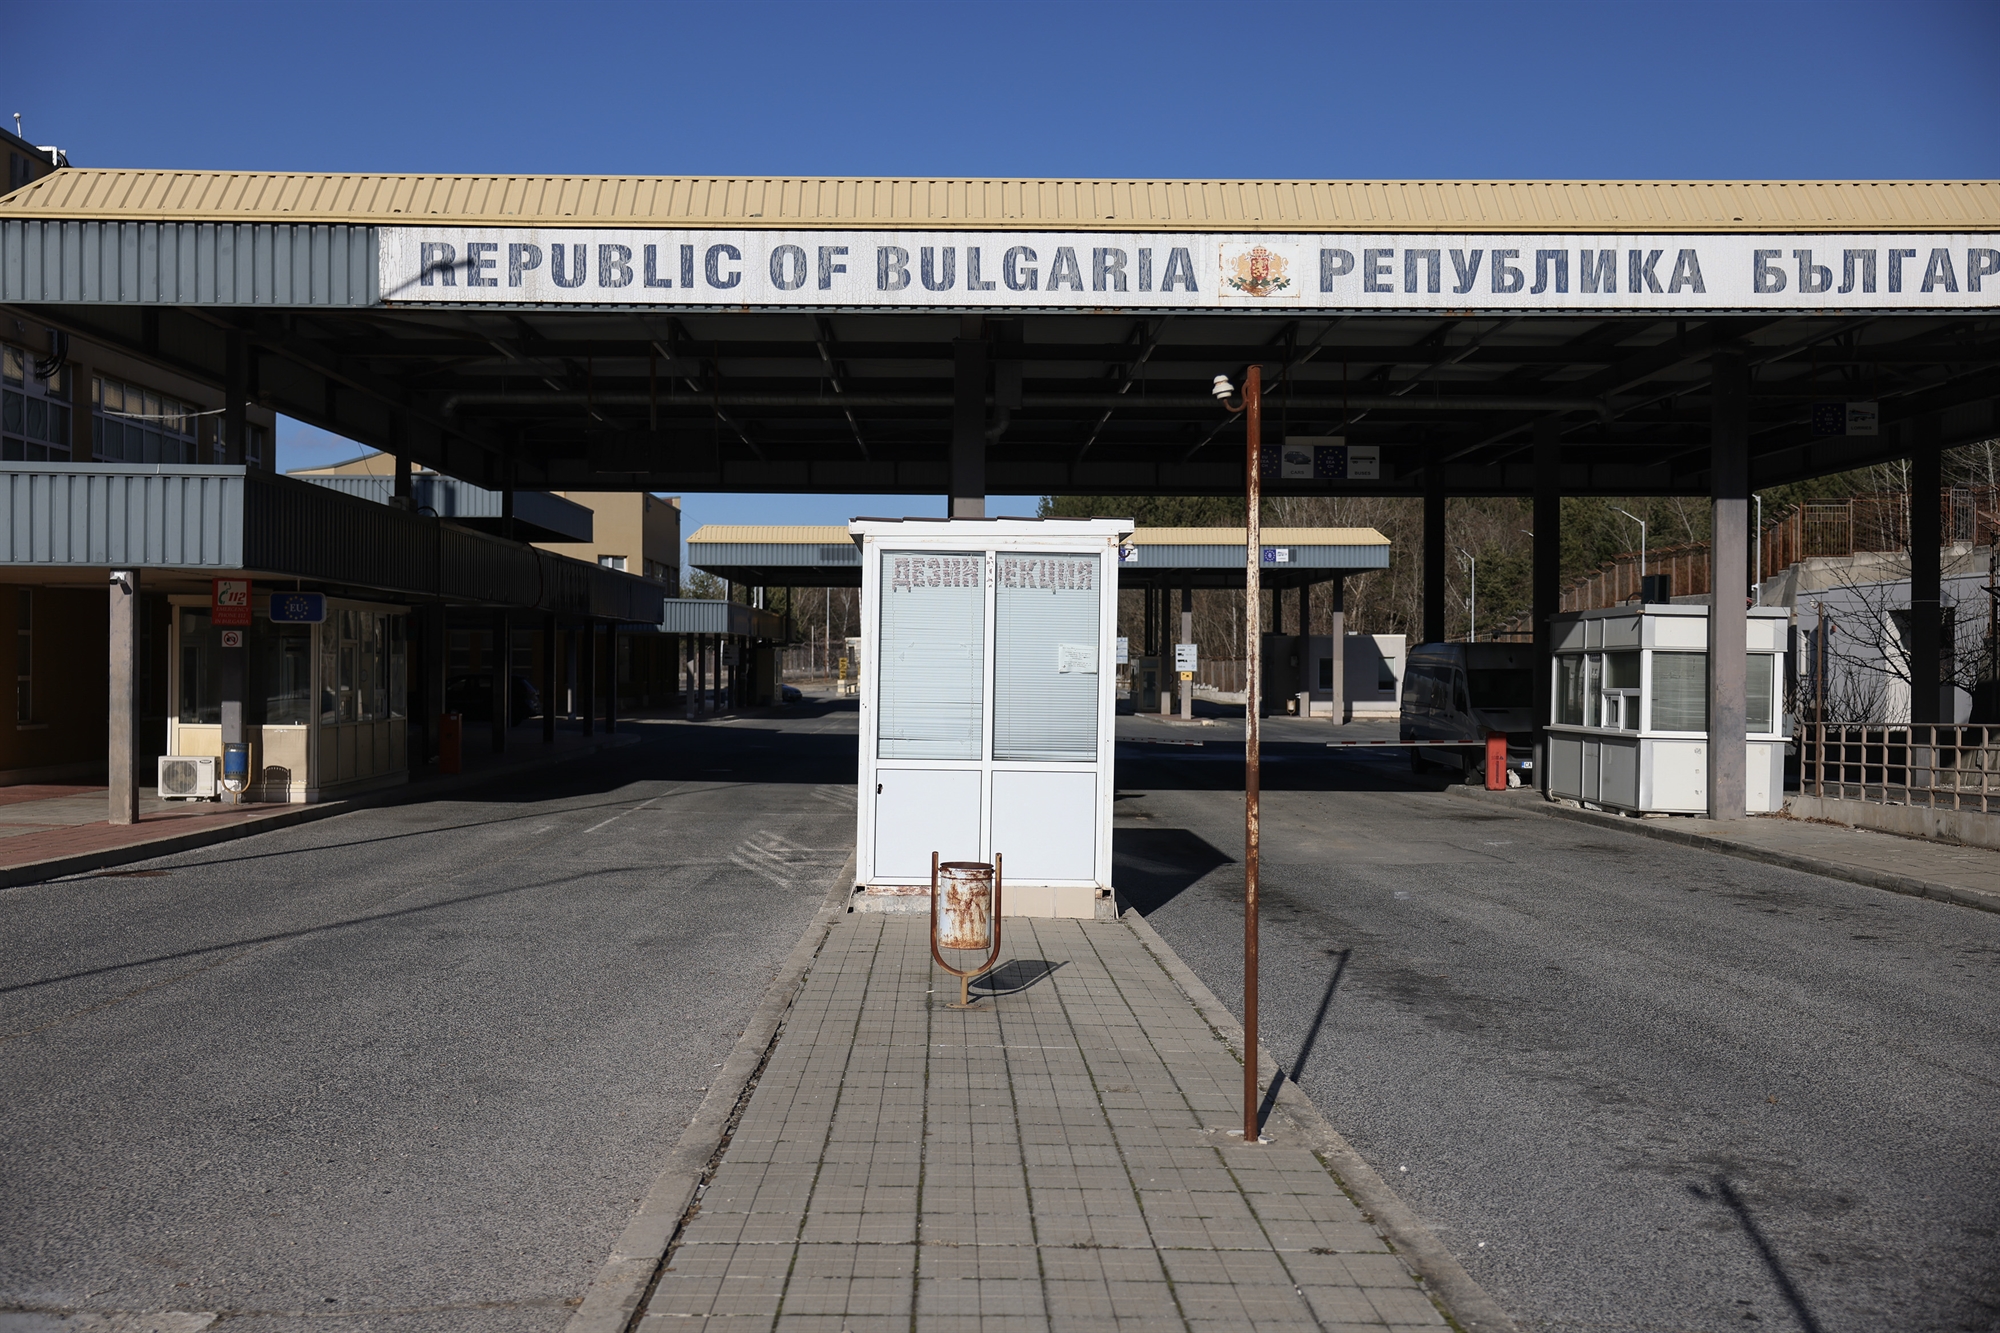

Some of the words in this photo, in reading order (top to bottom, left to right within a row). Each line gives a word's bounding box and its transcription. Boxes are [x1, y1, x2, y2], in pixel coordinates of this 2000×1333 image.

[420, 241, 742, 290] REPUBLIC
[769, 244, 849, 290] OF
[876, 245, 1200, 292] BULGARIA
[1318, 247, 1707, 294] РЕПУБЛИКА
[1753, 248, 2000, 294] БЪЛГАР
[228, 592, 247, 602] 112
[289, 603, 304, 612] EU
